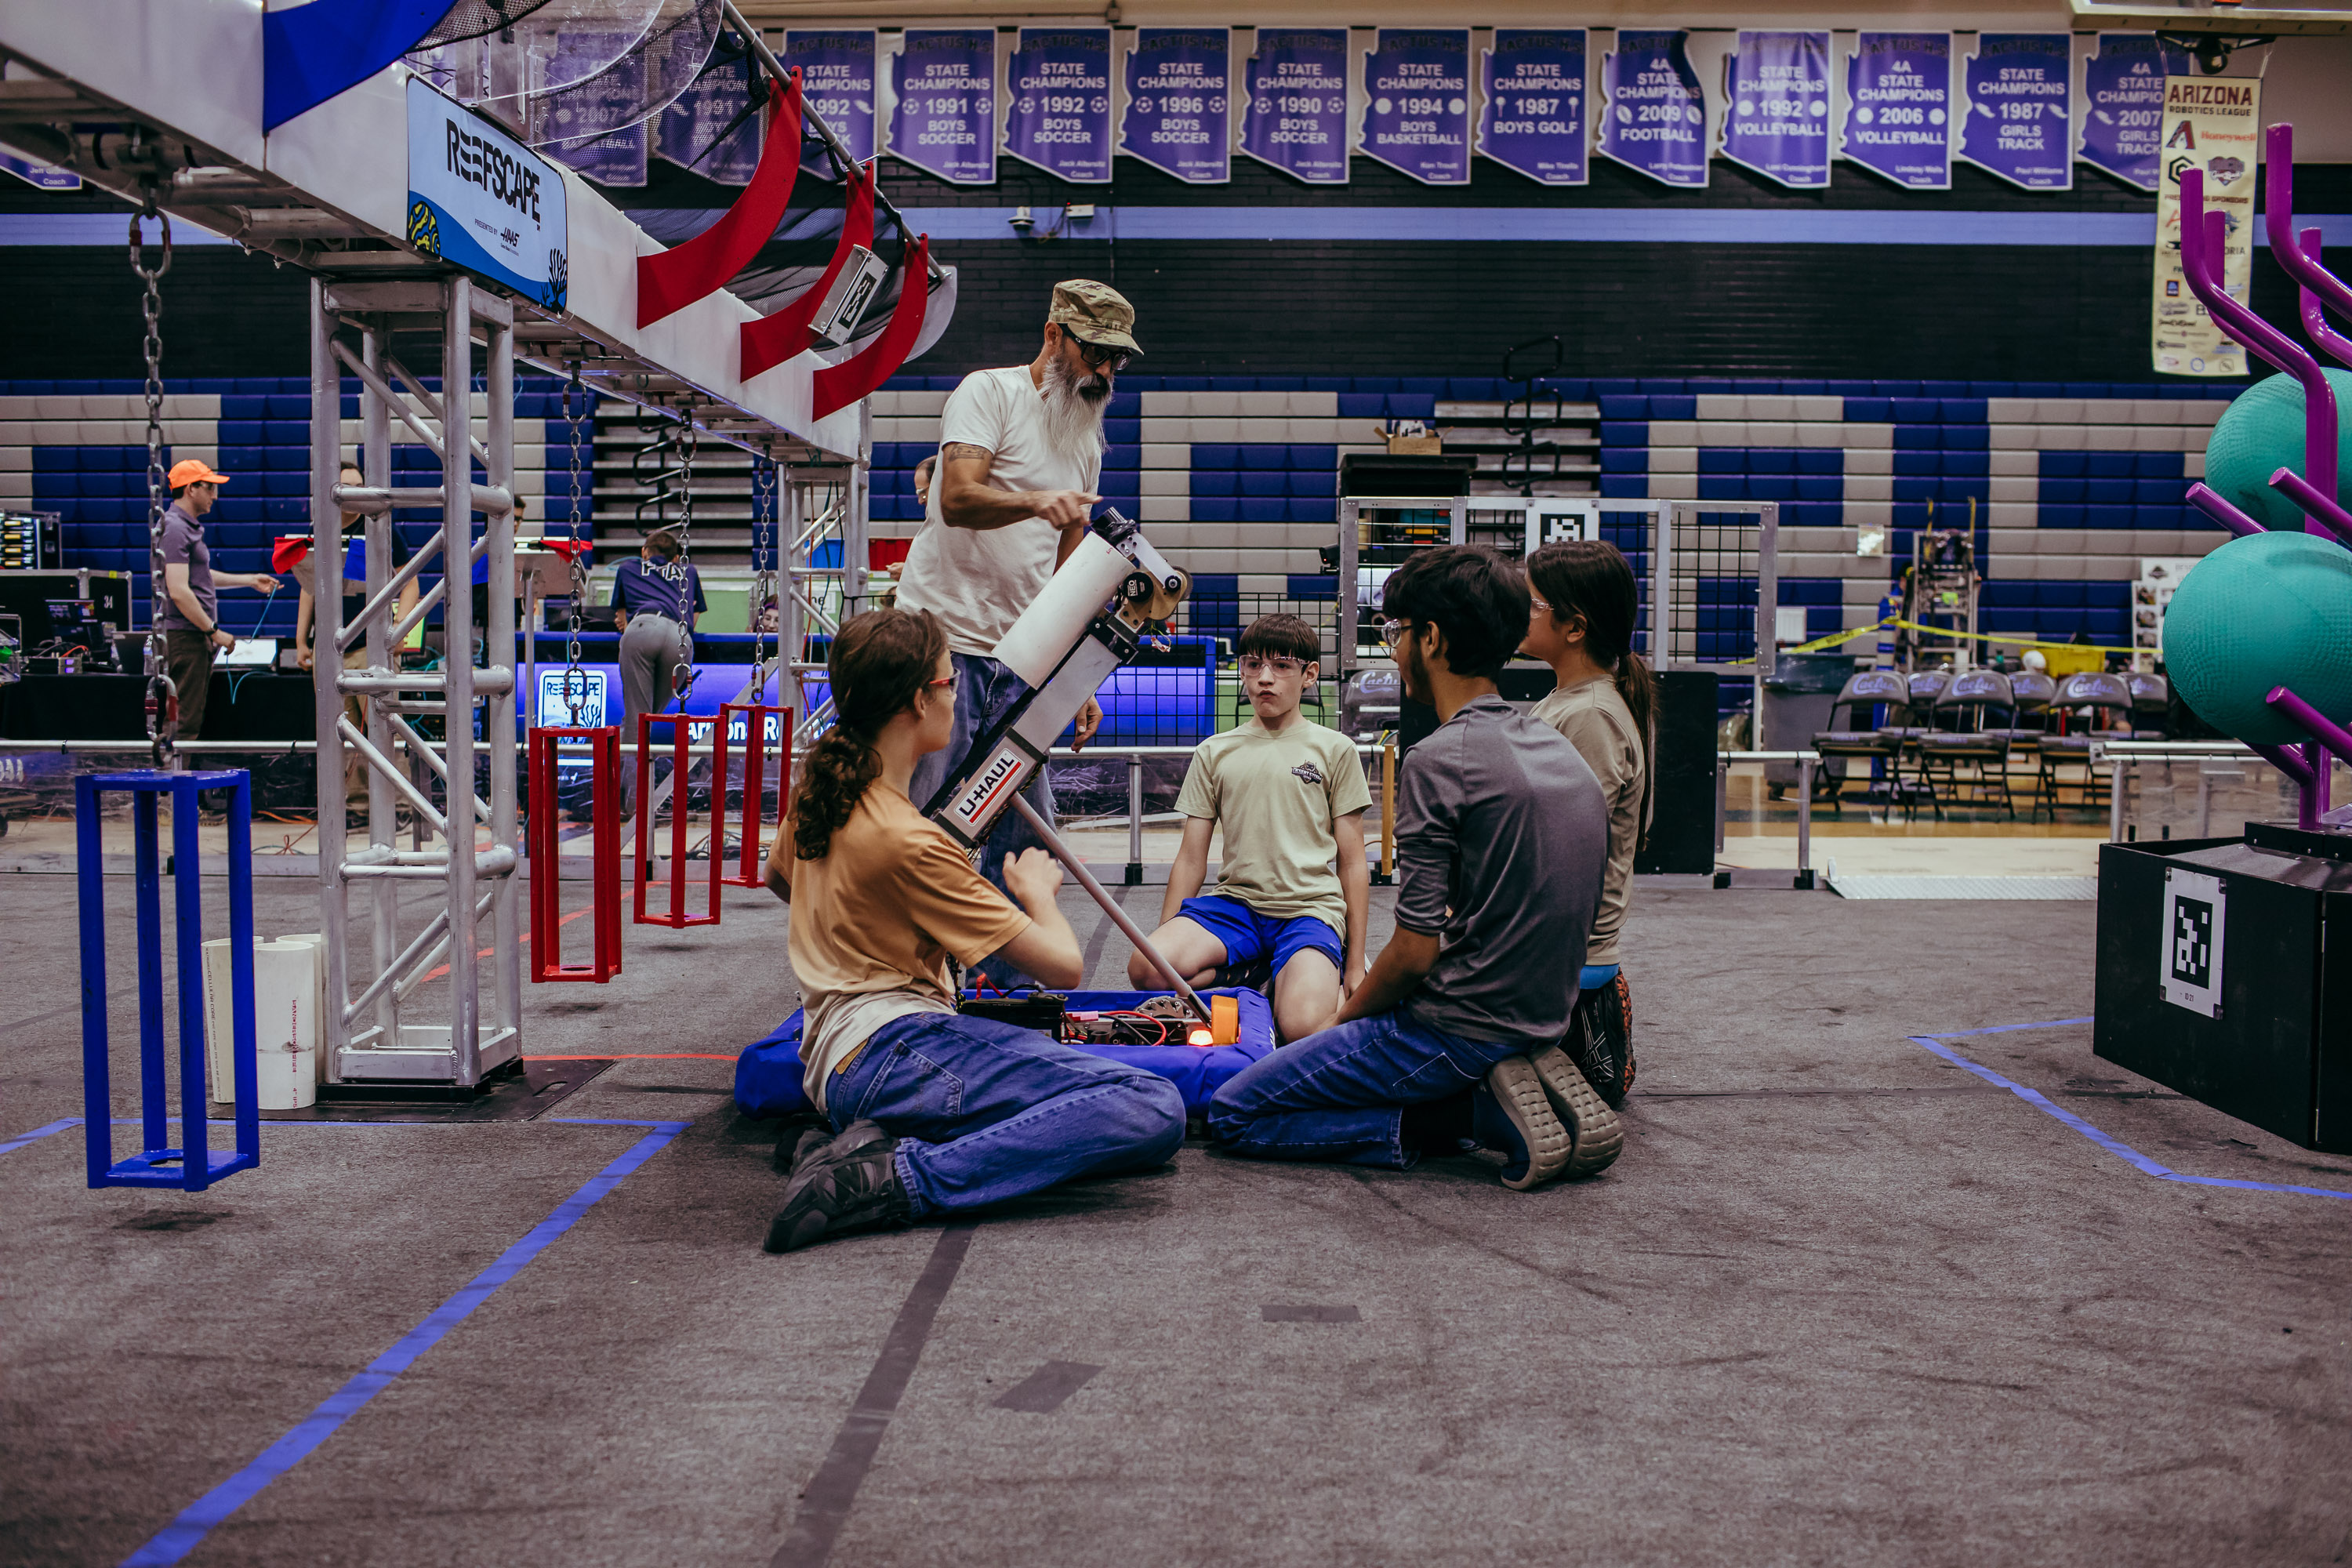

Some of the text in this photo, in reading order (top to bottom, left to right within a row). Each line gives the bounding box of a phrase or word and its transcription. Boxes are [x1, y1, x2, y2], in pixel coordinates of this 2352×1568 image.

[925, 64, 969, 76] STATE
[1040, 64, 1085, 74] STATE
[1159, 64, 1203, 74] STATE
[1278, 64, 1323, 75] STATE
[1399, 64, 1443, 75] STATE
[1515, 64, 1561, 76] STATE
[1650, 58, 1670, 70] 4A
[1892, 60, 1912, 72] 4A
[2132, 63, 2151, 74] 4A
[807, 65, 851, 78] STATE
[1759, 66, 1803, 78] STATE
[2000, 68, 2045, 81] STATE
[802, 79, 871, 91] HAMPIONS
[904, 78, 990, 90] CHAMPIONS
[1020, 78, 1106, 89] CHAMPIONS
[1138, 78, 1224, 89] CHAMPIONS
[1257, 78, 1343, 89] CHAMPIONS
[1377, 78, 1464, 89] CHAMPIONS
[1494, 78, 1581, 90] CHAMPIONS
[1638, 73, 1681, 85] STATE
[1879, 74, 1924, 87] STATE
[2118, 77, 2163, 89] STATE
[1737, 80, 1825, 93] CHAMPIONS
[1978, 82, 2065, 95] CHAMPIONS
[1616, 87, 1701, 99] CHAMPIONS
[1857, 89, 1944, 102] CHAMPIONS
[2096, 91, 2164, 103] CHAMPIO
[2169, 85, 2252, 106] ARIZONA
[808, 99, 851, 115] 1992
[925, 98, 967, 114] 1991
[1040, 96, 1085, 113] 1992
[1159, 96, 1203, 113] 1996
[1278, 97, 1322, 114] 1990
[1398, 98, 1443, 114] 1994
[1515, 98, 1559, 114] 1987
[1759, 100, 1803, 117] 1992
[2169, 105, 2251, 116] ROBOTICS LEAGUE
[1638, 105, 1681, 122] 2009
[1879, 107, 1923, 125] 2006
[2000, 103, 2045, 119] 1987
[1043, 118, 1082, 130] BOYS
[1161, 119, 1200, 130] BOYS
[2118, 111, 2162, 126] 2007
[808, 122, 847, 133] BYS
[928, 120, 966, 131] BOYS
[1280, 119, 1319, 131] BOYS
[1400, 122, 1436, 132] BOYS
[1494, 122, 1578, 134] BOYS GOLF
[1734, 122, 1825, 136] VOLLEYBALL
[2000, 125, 2042, 137] GIRLS
[918, 133, 975, 144] SOCCER
[1034, 132, 1091, 143] SOCCER
[1152, 132, 1210, 143] SOCCER
[1270, 132, 1328, 143] SOCCER
[1377, 133, 1462, 144] BASKETBALL
[1621, 128, 1697, 142] FOOTBALL
[1856, 131, 1945, 145] VOLLEYBALL
[2119, 130, 2159, 141] GIRLS
[2201, 132, 2256, 143] Honeywell
[1997, 138, 2045, 150] TRACK
[446, 118, 540, 223] REEFSCAPE
[475, 218, 493, 233] PRESENTED
[641, 560, 683, 581] FTA
[1128, 579, 1137, 597] NEO
[103, 595, 113, 608] 34
[1853, 673, 1896, 695] Cactus
[1952, 673, 1996, 696] Cactus
[2067, 675, 2114, 698] Cactus
[959, 758, 1014, 815] U-HAUL
[2189, 993, 2194, 1002] 21
